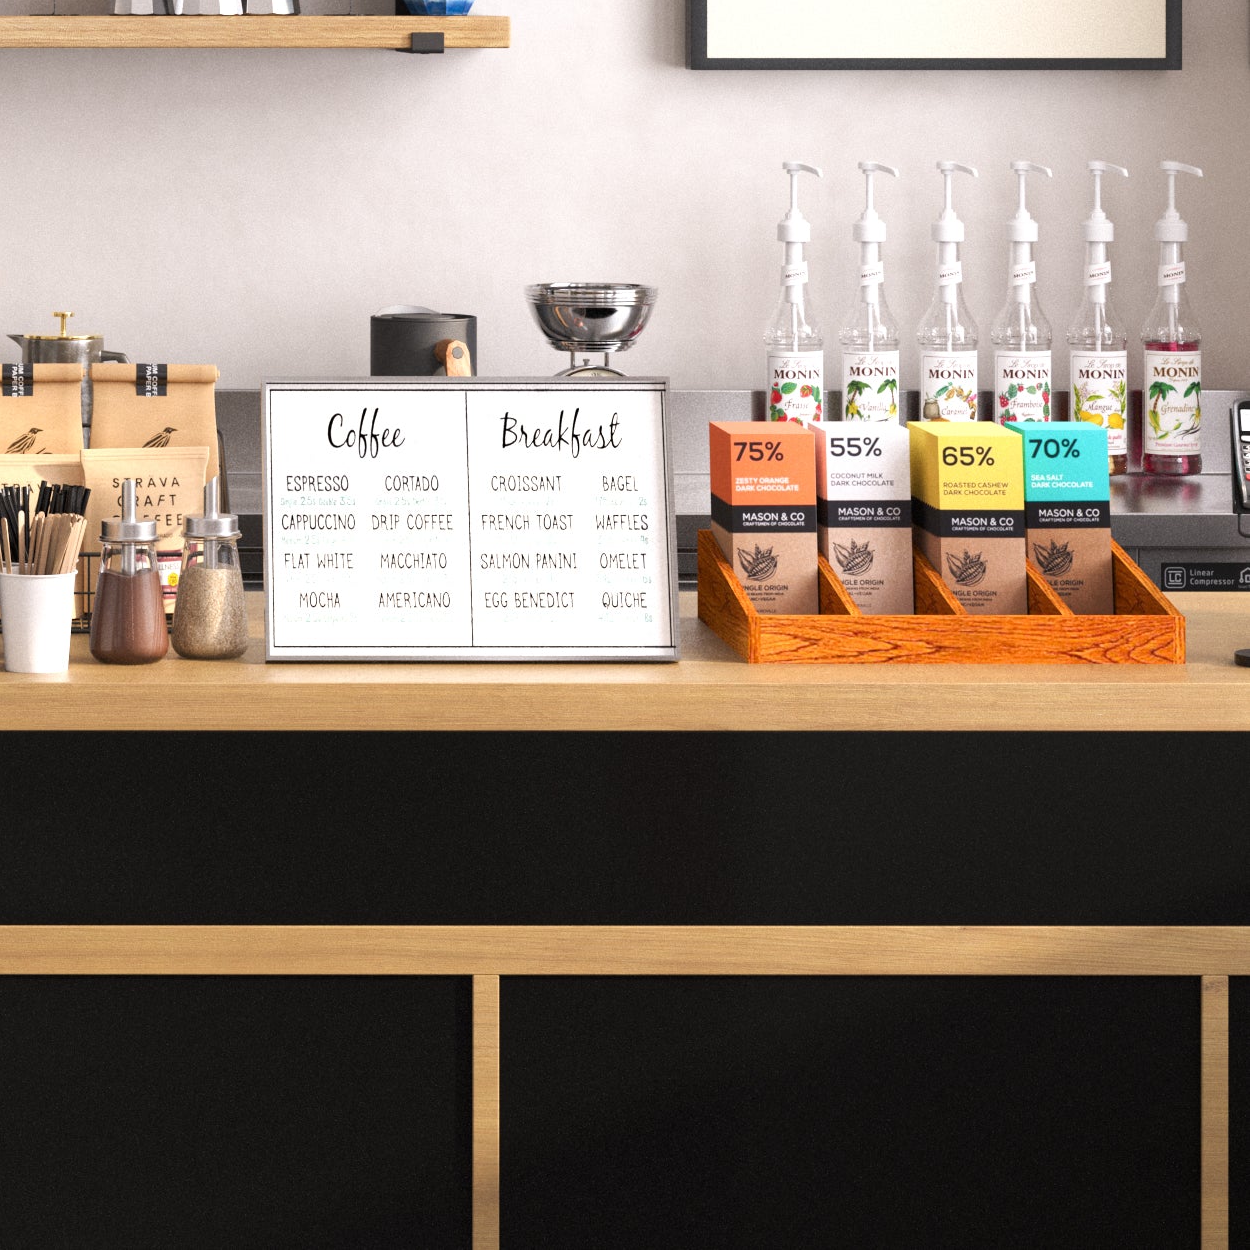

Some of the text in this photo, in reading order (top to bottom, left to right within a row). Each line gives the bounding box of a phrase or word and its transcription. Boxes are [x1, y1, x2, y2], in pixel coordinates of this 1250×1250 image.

[774, 369, 820, 379] MONIN
[850, 366, 896, 377] MONIN
[929, 369, 974, 379] MONIN
[1002, 369, 1049, 379] MONIN
[1078, 369, 1125, 379] MONIN
[1153, 366, 1199, 377] MONIN
[328, 408, 405, 458] Coffee
[500, 408, 622, 458] Breakfast
[734, 442, 784, 461] 75%
[830, 437, 882, 457] 55%
[1029, 438, 1080, 458] 70%
[942, 446, 995, 466] 65%
[286, 475, 349, 491] ESPRESSO
[385, 475, 439, 491] CORTADO
[491, 475, 562, 491] CROISSANT
[603, 475, 638, 491] BAGEL
[742, 512, 805, 521] MASON & CO
[838, 507, 901, 516] MASON & CO
[1038, 508, 1100, 517] MASON & CO
[281, 514, 356, 530] CAPPUCCINO
[372, 514, 453, 530] DRIP COFFEE
[481, 514, 573, 530] FRENCH TOAST
[596, 514, 649, 530] WAFFLES
[951, 517, 1014, 526] MASON & CO
[284, 553, 354, 569] FLAT WHITE
[380, 553, 447, 569] MACCHIATO
[480, 553, 577, 569] SALMON PANINI
[600, 553, 647, 569] OMELET
[1190, 578, 1235, 586] Compressor
[300, 592, 340, 608] MOCHA
[379, 592, 450, 608] AMERICANO
[484, 592, 574, 608] EGG BENEDICT
[602, 592, 647, 608] QUICHE
